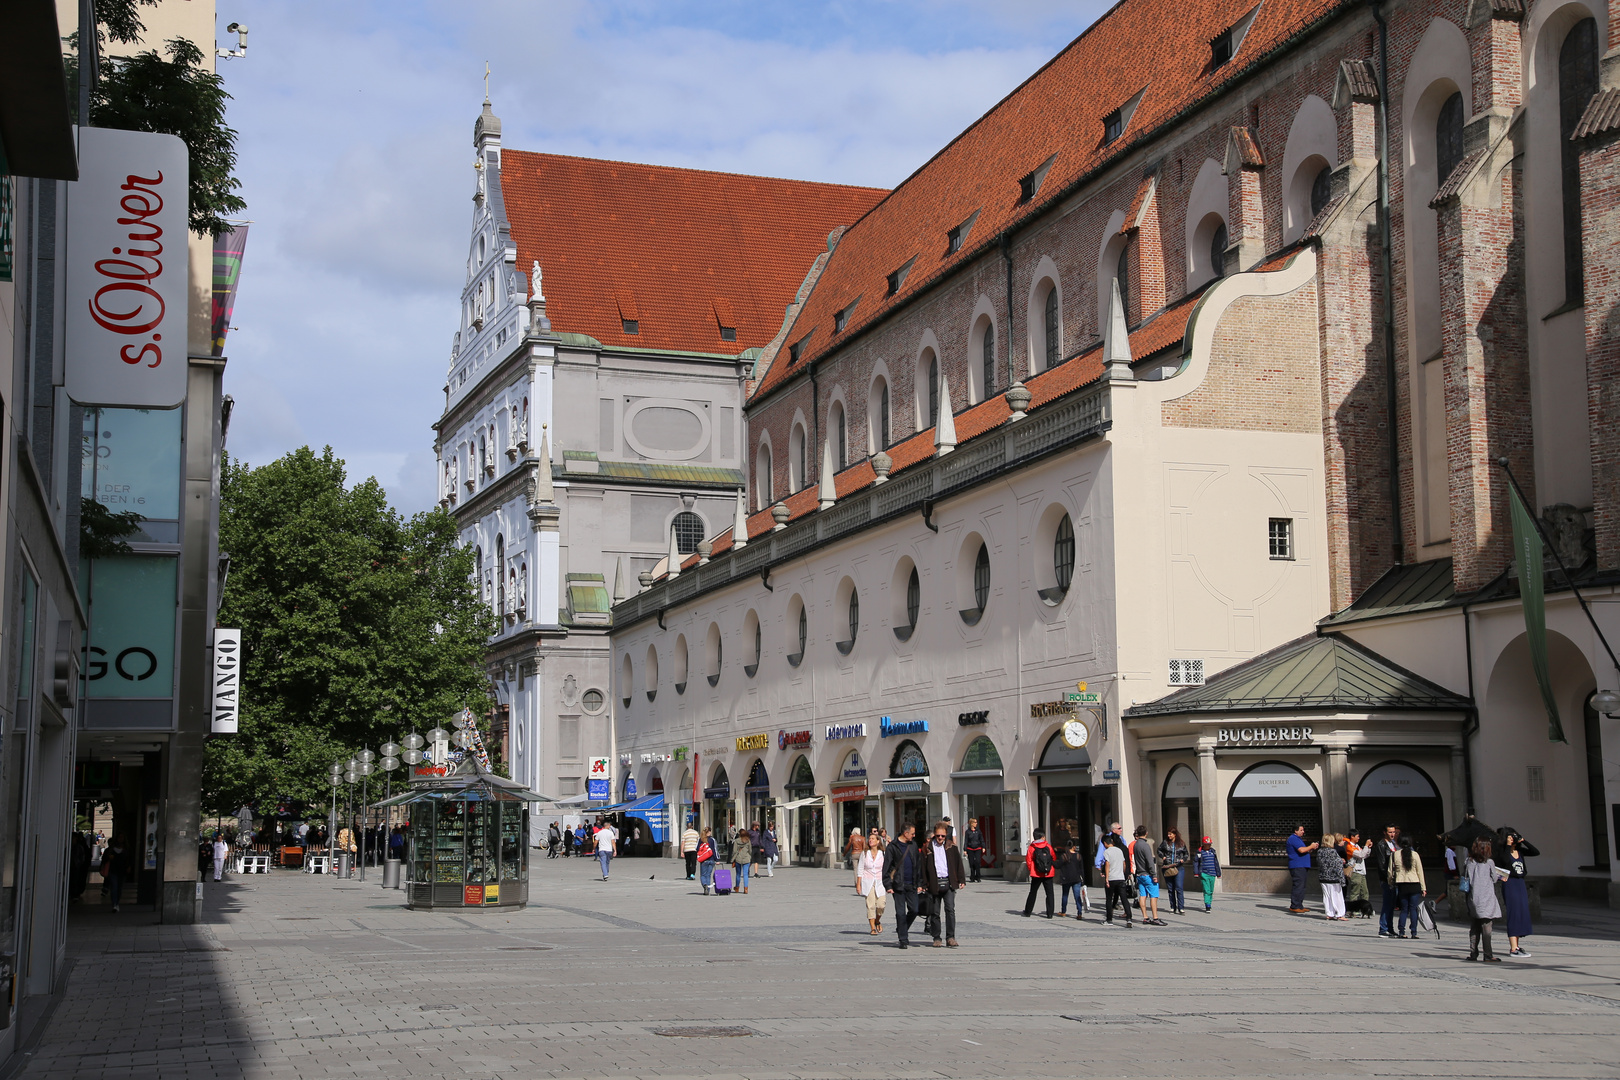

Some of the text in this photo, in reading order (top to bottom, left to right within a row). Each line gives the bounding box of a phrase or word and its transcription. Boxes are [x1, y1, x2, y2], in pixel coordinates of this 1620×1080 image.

[88, 169, 166, 369] s.Oliver
[104, 484, 131, 493] DER
[215, 638, 238, 722] MANGO
[1069, 693, 1098, 702] ROLEX
[825, 722, 867, 740] Lederwaren
[1217, 726, 1314, 742] BUCHERER
